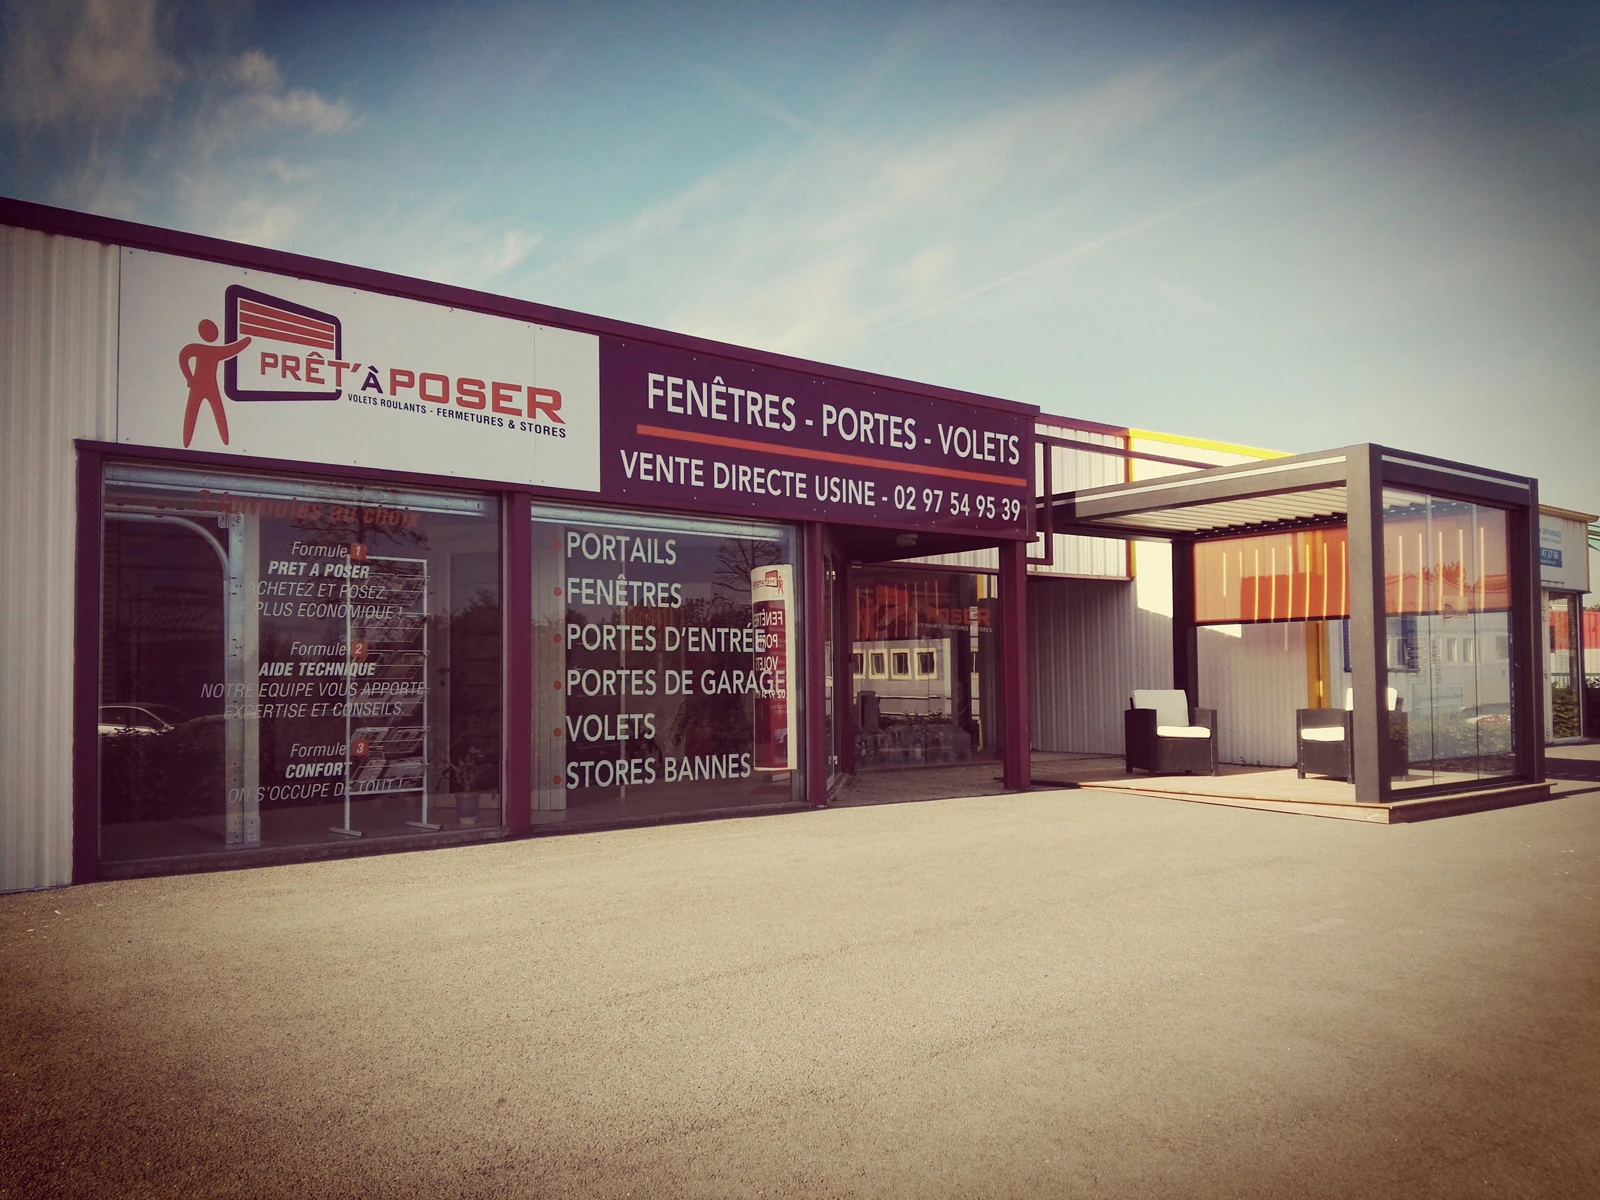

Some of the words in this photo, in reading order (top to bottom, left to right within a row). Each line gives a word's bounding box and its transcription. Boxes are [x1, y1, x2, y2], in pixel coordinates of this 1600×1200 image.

[389, 367, 566, 425] POSER
[347, 392, 379, 407] VOLETS
[380, 397, 427, 415] ROULANTS
[436, 407, 504, 428] FERMETURES
[507, 418, 516, 430] &
[519, 420, 567, 439] STORES
[647, 371, 796, 433] FENÊTRES
[822, 403, 917, 451] PORTES
[937, 423, 1021, 467] VOLETS
[620, 449, 704, 487] VENTE
[713, 461, 808, 499] DIRECTE
[814, 475, 876, 507] USINE
[893, 485, 917, 511] 02
[922, 489, 943, 513] 97
[949, 492, 970, 516] 54
[975, 495, 996, 519] 95
[1001, 497, 1021, 521] 39
[291, 541, 348, 558] Formule
[566, 531, 677, 565] PORTAILS
[267, 560, 307, 576] PRET
[310, 563, 320, 577] A
[324, 563, 370, 579] POSER
[247, 580, 313, 598] ACHETEZ
[317, 583, 337, 598] ET
[567, 573, 682, 609] FENÊTRES
[256, 601, 293, 617] PLUS
[297, 603, 394, 620] ECONOMIQUE
[567, 623, 657, 652] PORTES
[664, 622, 766, 653] D'ENTRÉE
[290, 641, 346, 656] Formule
[354, 643, 363, 654] 2
[258, 662, 294, 677] AIDE
[298, 662, 376, 677] TECHNIQUE
[200, 682, 255, 699] NOTRE
[258, 682, 315, 698] EQUIPE
[319, 682, 358, 697] VOUS
[362, 681, 425, 696] APPORTE
[567, 669, 657, 696] PORTES
[664, 669, 694, 696] DE
[700, 669, 786, 696] GARAGE
[222, 703, 308, 720] EXPERTISE
[310, 703, 330, 718] ET
[565, 712, 657, 742] VOLETS
[290, 741, 347, 758] Formule
[356, 742, 364, 754] 3
[284, 761, 353, 779] CONFORT
[565, 756, 657, 790] STORES
[664, 752, 751, 783] BANNES
[255, 782, 330, 803] S'OCCUPE
